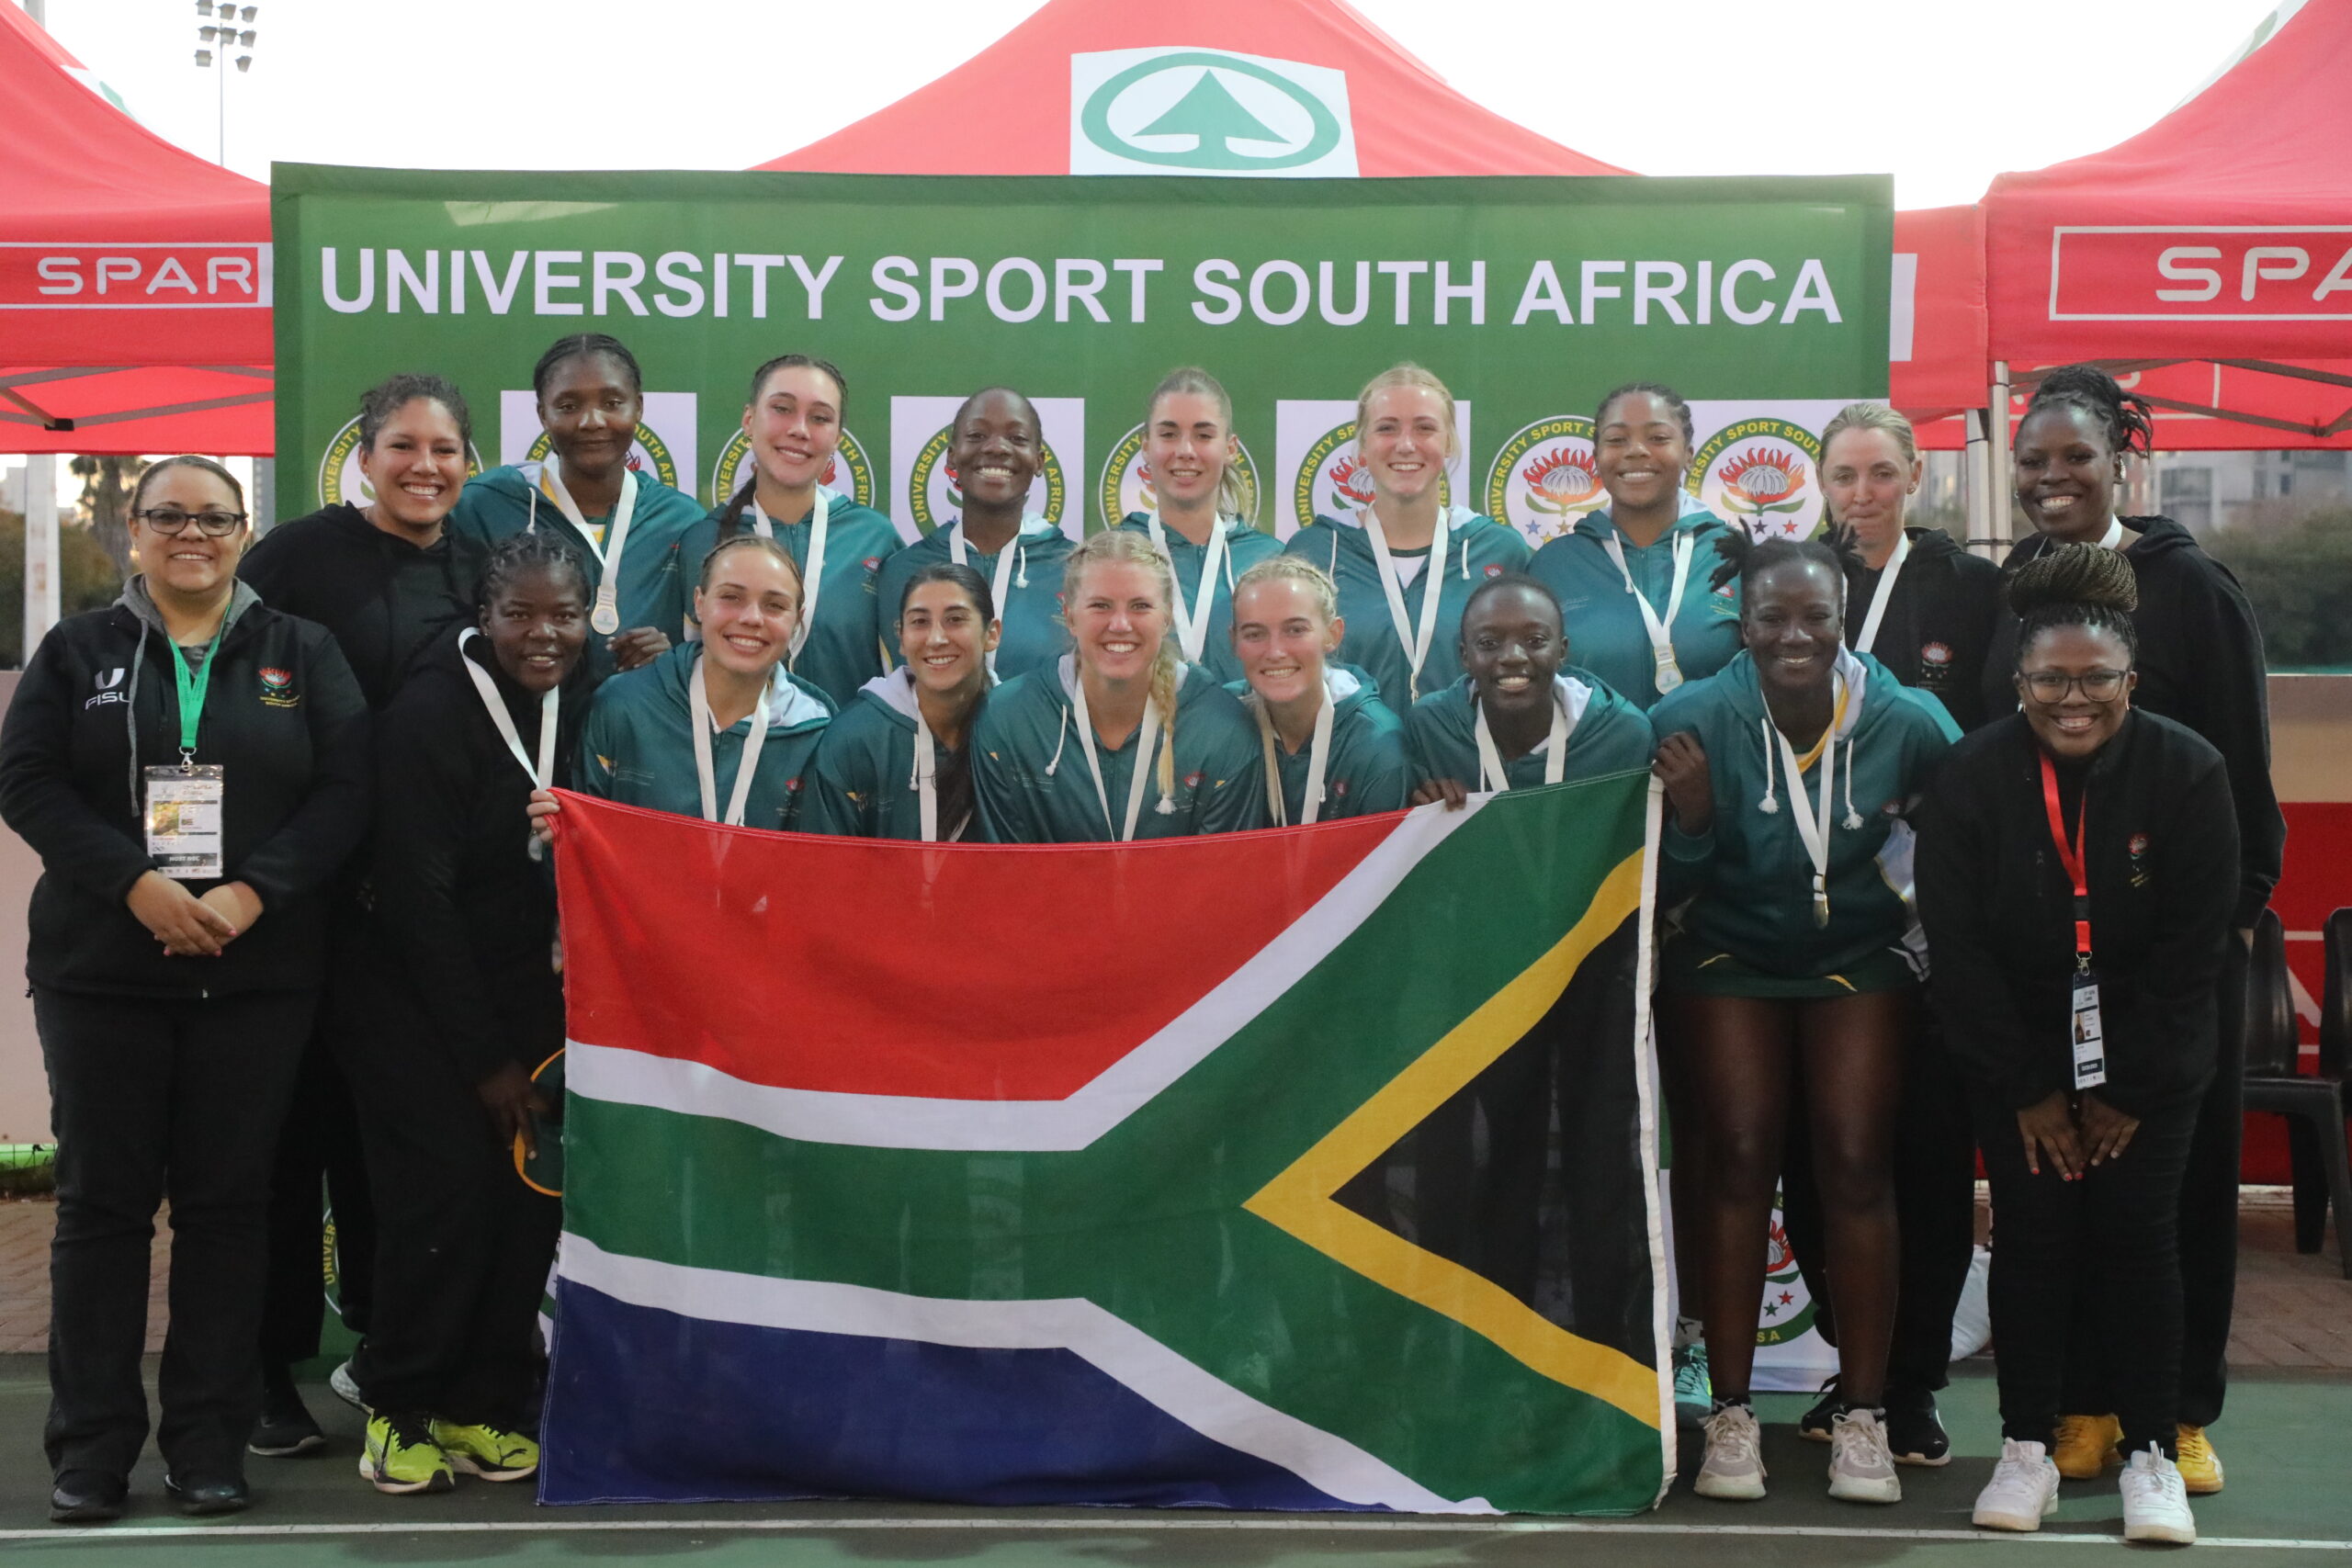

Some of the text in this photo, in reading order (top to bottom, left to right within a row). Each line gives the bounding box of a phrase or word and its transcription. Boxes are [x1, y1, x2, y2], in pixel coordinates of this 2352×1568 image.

[37, 256, 253, 295] SPAR
[322, 247, 1842, 325] UNIVERSITY SPORT SOUTH AFRICA
[2155, 246, 2352, 302] SPA
[1531, 422, 1584, 440] SPORT
[1726, 422, 1781, 440] SPORT
[1783, 425, 1822, 456] SOUT
[325, 424, 362, 504] NIVERSITY
[912, 433, 949, 523] UNIVERSITY
[1105, 434, 1142, 525] UNIVERSITY
[1298, 436, 1335, 525] UNIVERSITY
[1046, 468, 1061, 522] AFRICA
[323, 1224, 335, 1285] UNIVER
